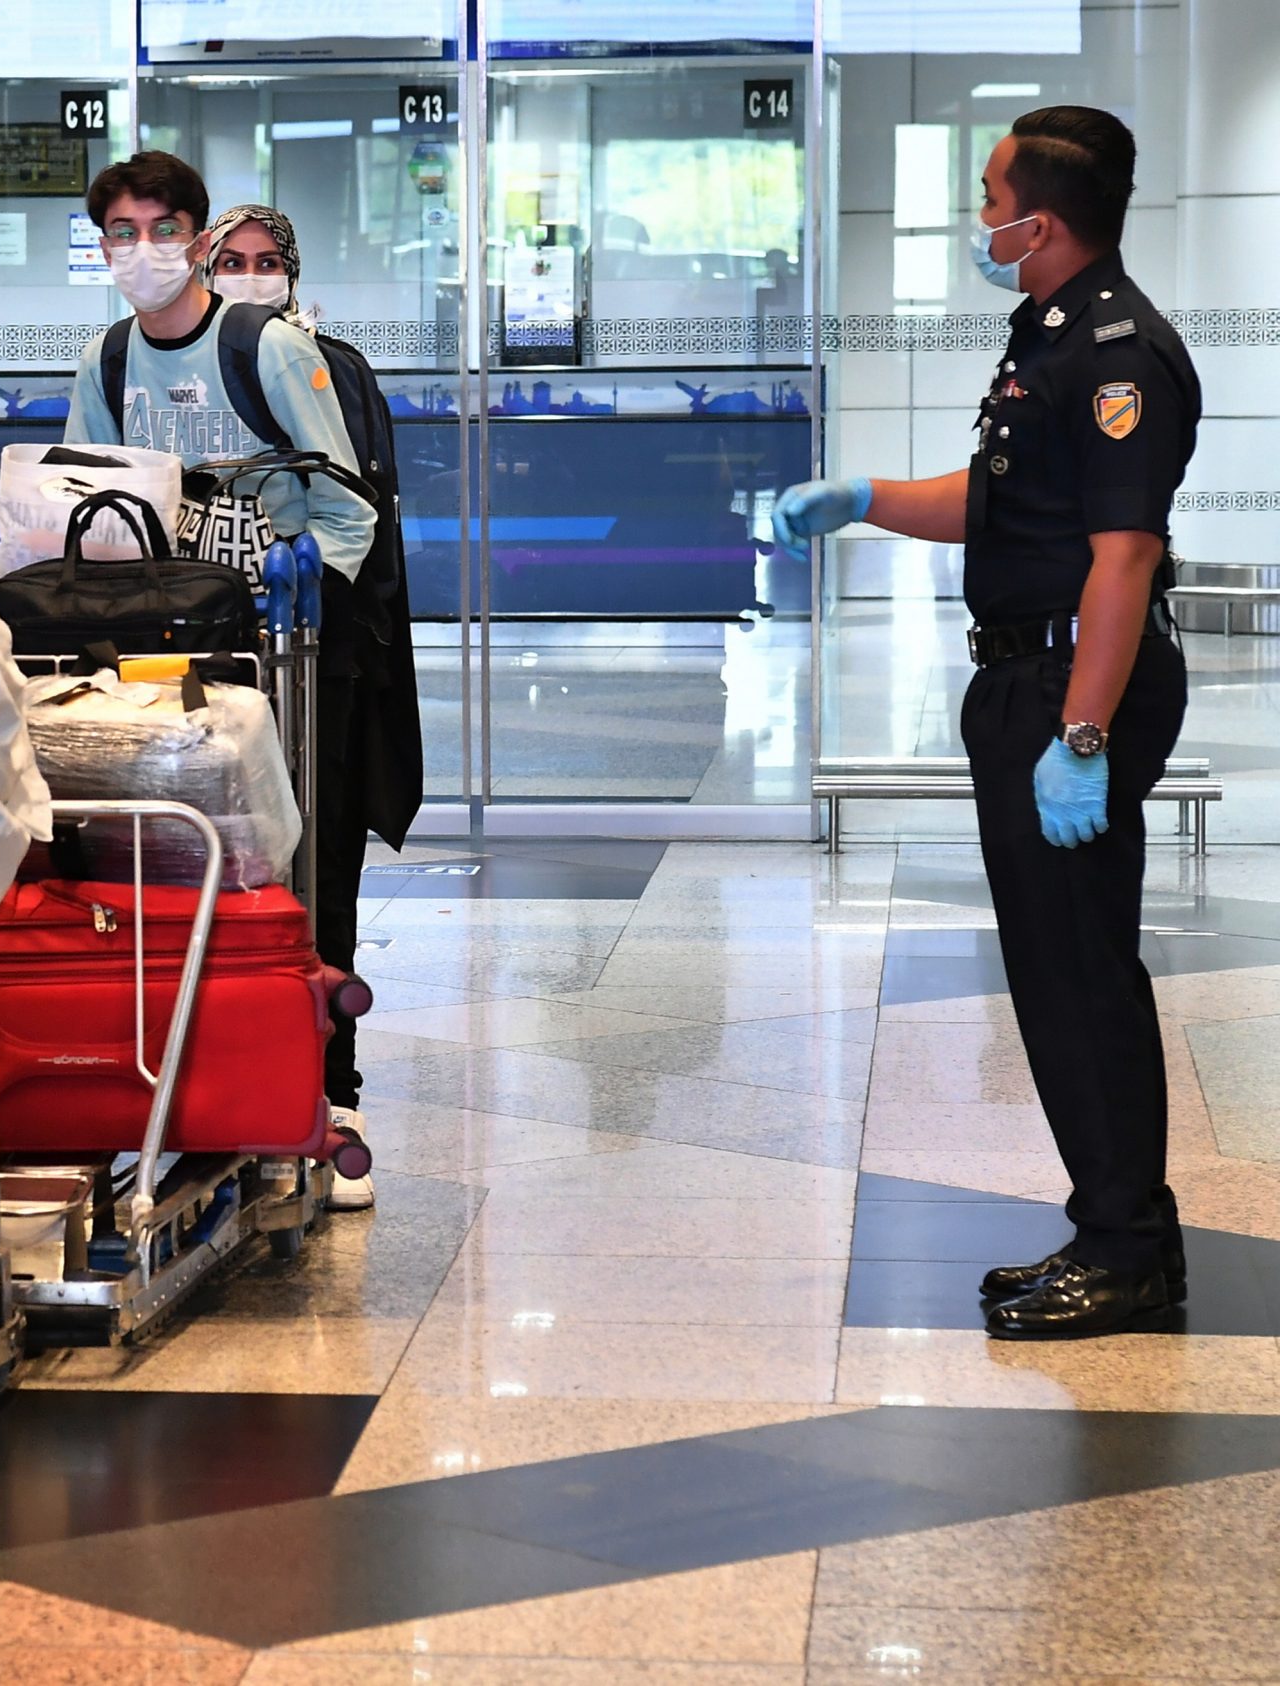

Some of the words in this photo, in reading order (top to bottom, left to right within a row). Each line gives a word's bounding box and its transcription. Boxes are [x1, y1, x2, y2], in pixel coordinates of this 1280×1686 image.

[65, 100, 79, 129] C
[83, 100, 104, 129] 12
[404, 95, 417, 123] C
[422, 95, 443, 123] 13
[749, 90, 761, 118] C
[767, 90, 789, 117] 14
[168, 389, 199, 403] MARVEL
[124, 392, 260, 454] AVENGERS
